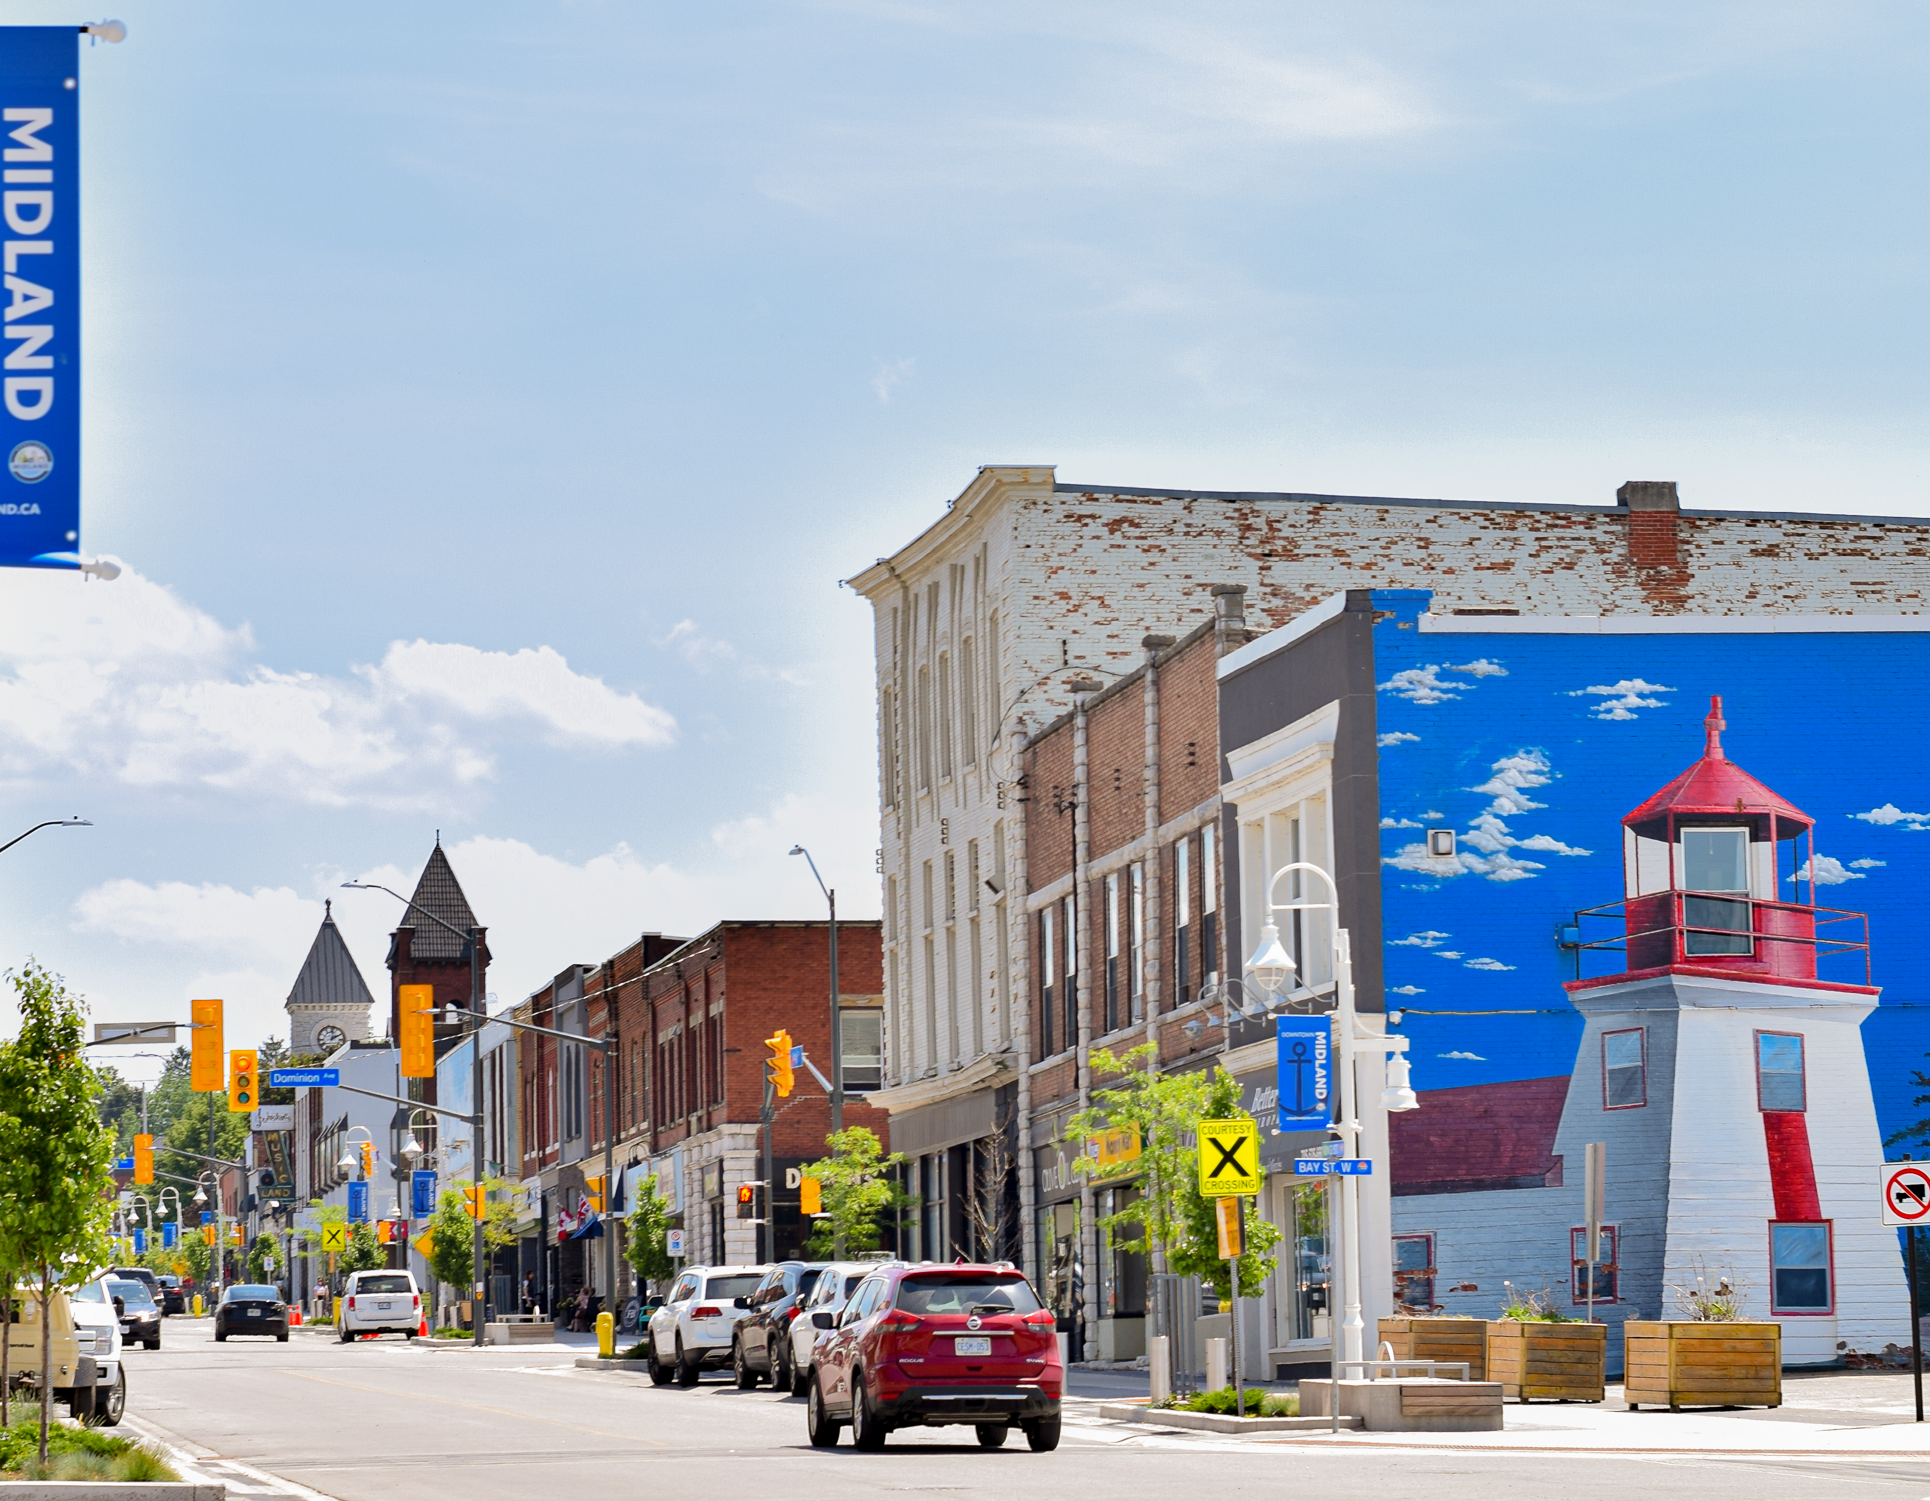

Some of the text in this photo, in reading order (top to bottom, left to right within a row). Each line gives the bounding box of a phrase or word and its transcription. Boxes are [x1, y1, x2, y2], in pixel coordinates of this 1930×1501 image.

[3, 108, 54, 421] MIDLAND
[1314, 1031, 1327, 1100] MIDLAND
[273, 1072, 319, 1083] Dominion
[1201, 1124, 1252, 1136] COURTESY
[267, 1131, 289, 1184] MUSIC
[1298, 1161, 1352, 1173] BAY ST. W
[1203, 1179, 1255, 1190] CROSSING
[261, 1188, 291, 1198] LAND
